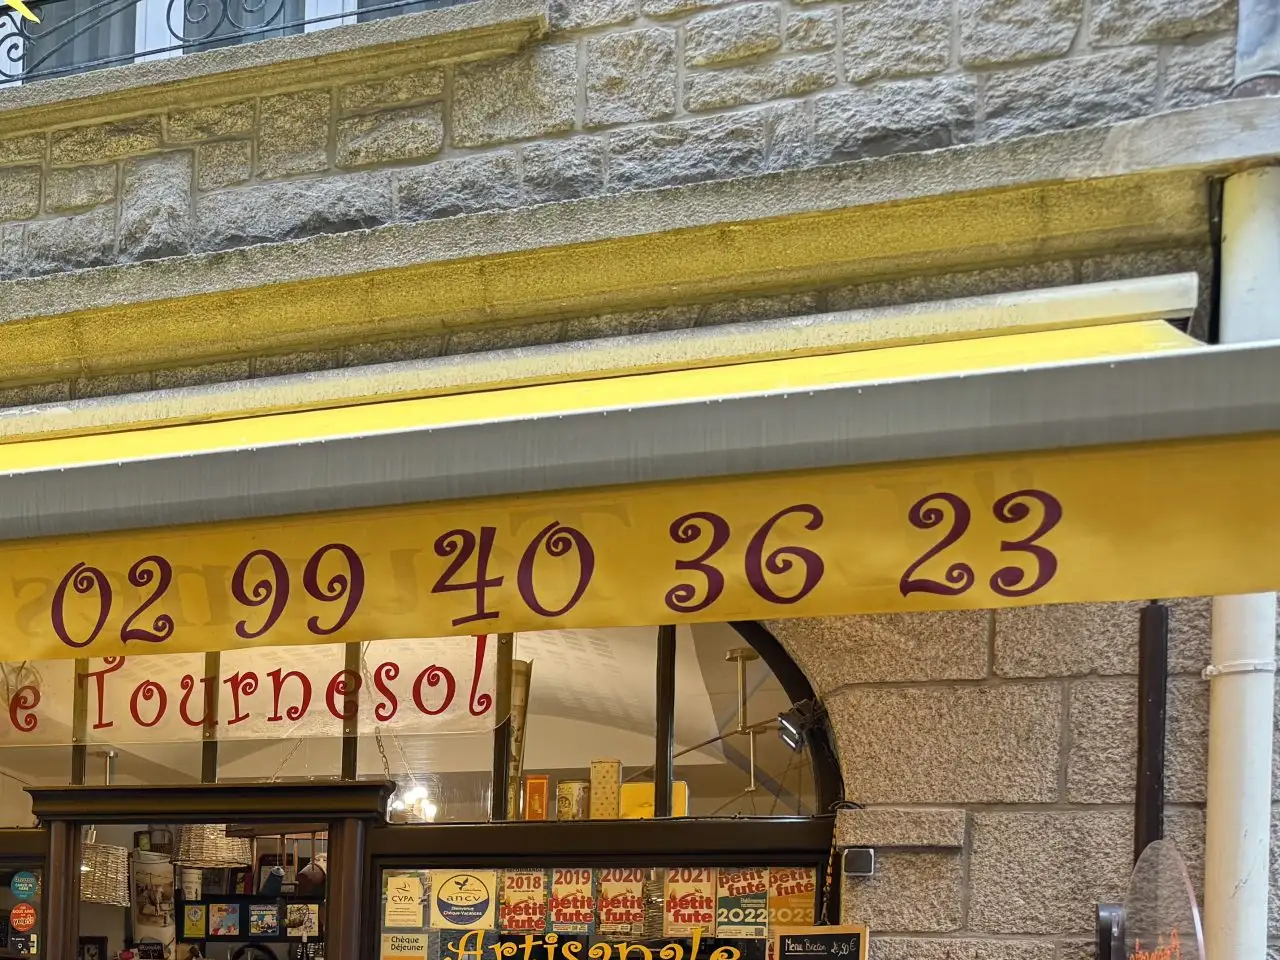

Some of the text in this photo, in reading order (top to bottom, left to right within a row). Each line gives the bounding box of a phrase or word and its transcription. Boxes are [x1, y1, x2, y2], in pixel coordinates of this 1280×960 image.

[51, 555, 175, 649] 02
[231, 542, 365, 640] 99
[431, 519, 596, 627] 40
[664, 503, 825, 614] 36
[899, 489, 1064, 598] 23
[78, 633, 494, 731] Tournesol
[506, 876, 542, 889] 2018
[554, 869, 591, 885] 2019
[600, 868, 644, 883] 2020
[667, 867, 711, 883] 2021
[719, 866, 765, 889] petit
[770, 867, 813, 888] petit
[727, 881, 766, 897] futé
[775, 881, 815, 897] futé
[446, 893, 481, 903] ancv
[548, 895, 596, 912] petit
[597, 895, 646, 912] petit
[665, 895, 713, 913] petit
[500, 902, 547, 919] petit
[717, 907, 768, 923] 2022
[770, 908, 815, 923] 2023
[390, 935, 420, 945] Chèque
[390, 943, 424, 953] Déjeuner
[785, 938, 803, 952] Menu
